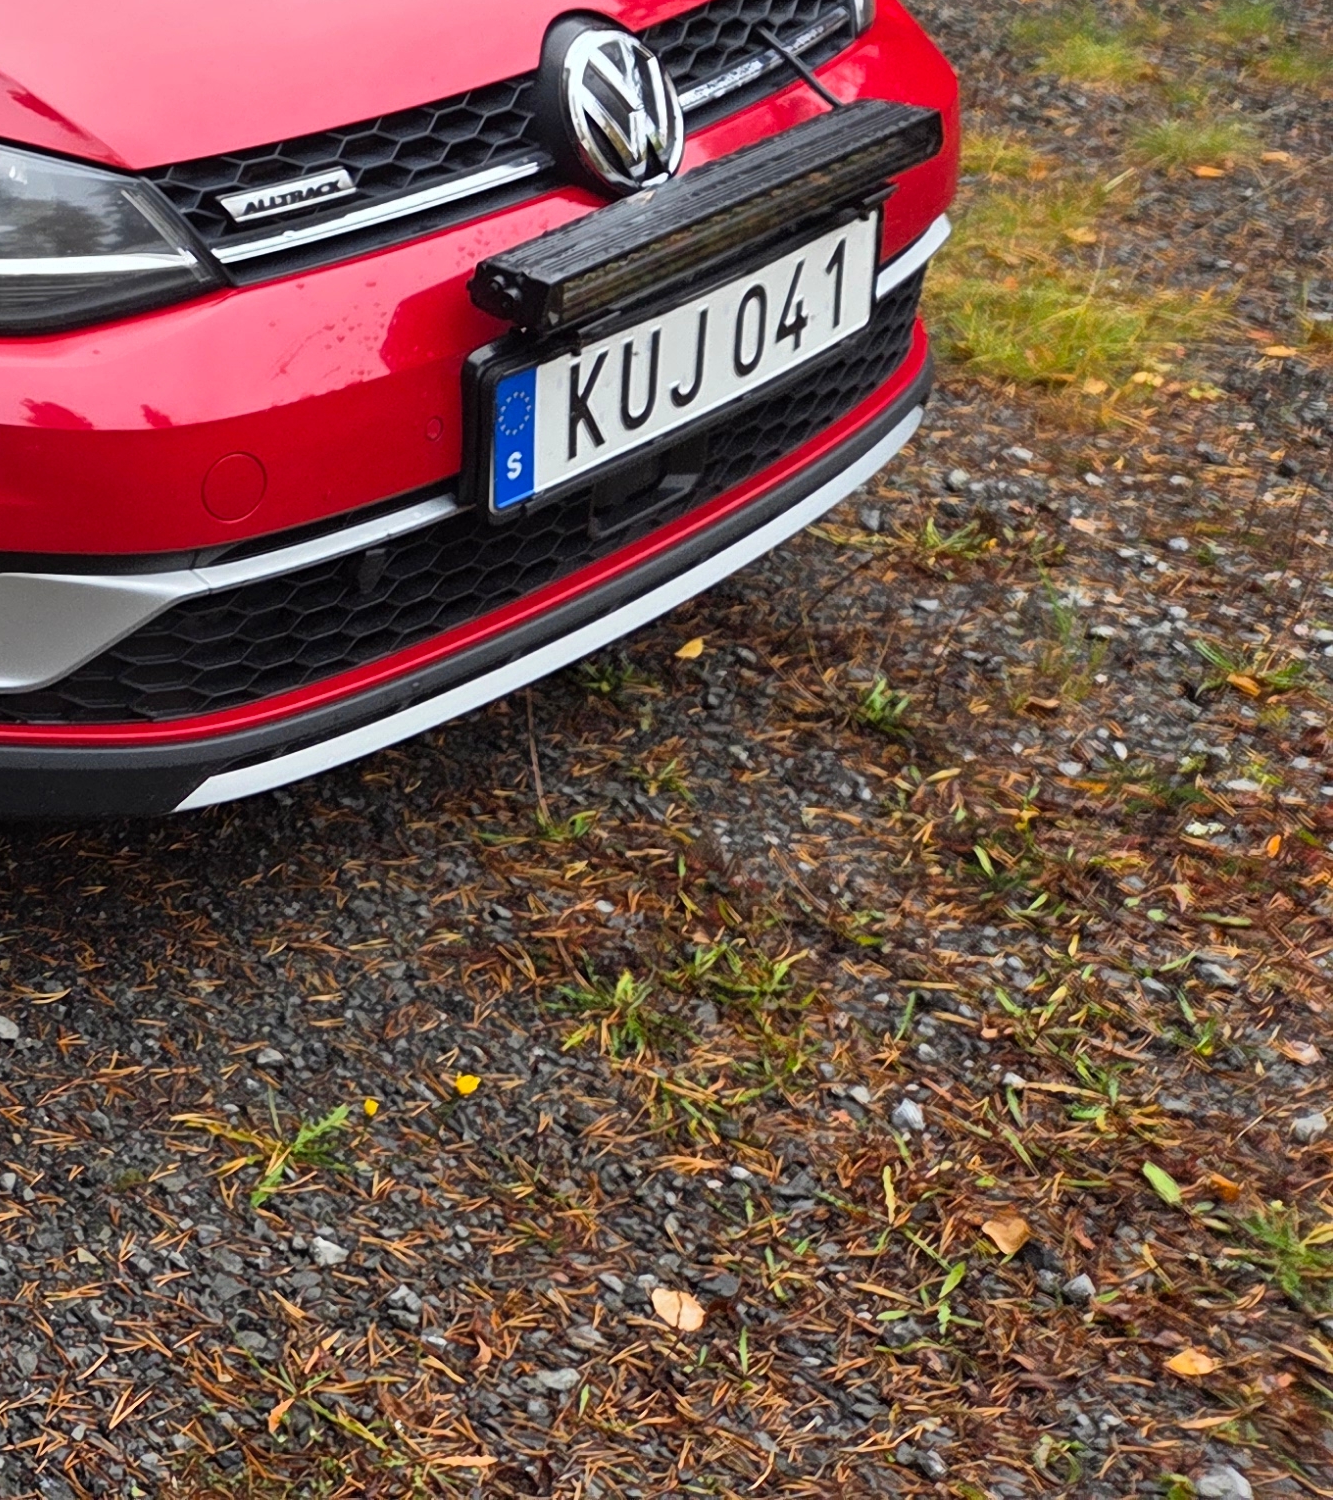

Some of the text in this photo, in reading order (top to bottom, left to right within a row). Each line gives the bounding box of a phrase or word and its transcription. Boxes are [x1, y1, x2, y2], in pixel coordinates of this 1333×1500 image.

[563, 30, 683, 188] VW
[242, 179, 343, 217] ALLTRACK
[567, 235, 848, 461] KUJ 041
[505, 450, 524, 480] S
